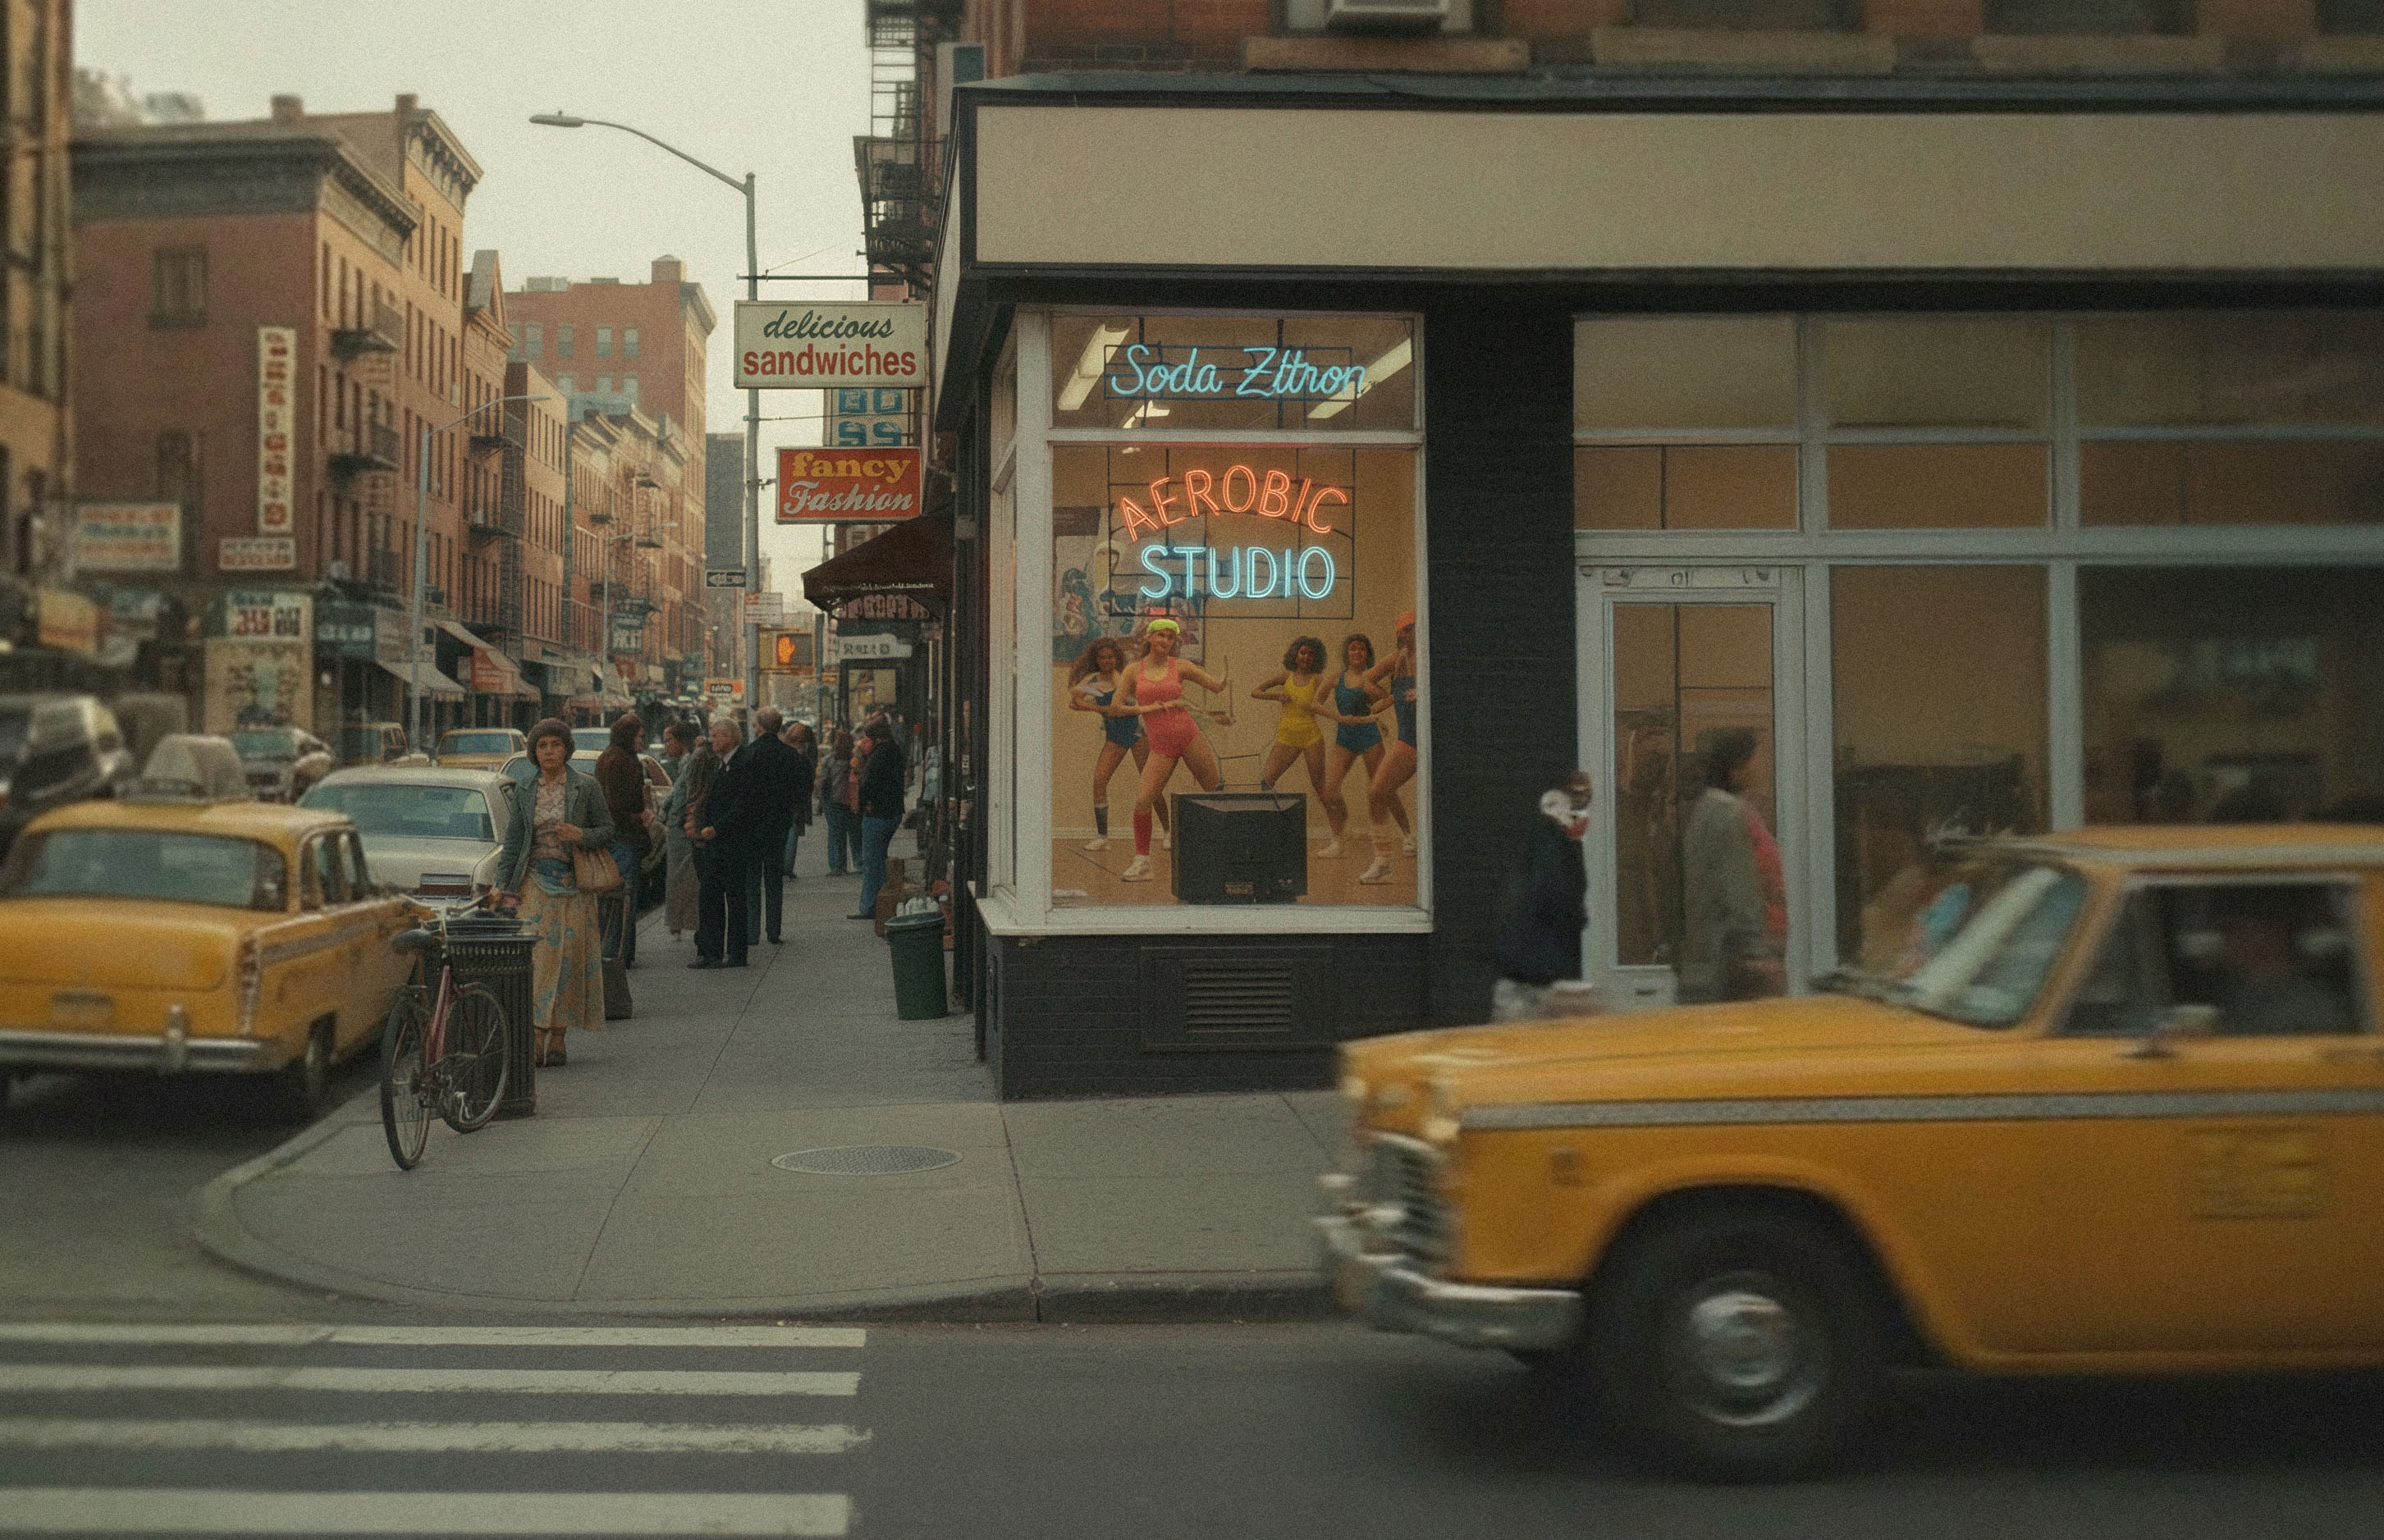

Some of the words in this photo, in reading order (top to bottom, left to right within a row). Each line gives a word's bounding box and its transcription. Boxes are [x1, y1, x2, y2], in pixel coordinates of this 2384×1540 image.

[763, 309, 895, 340] delicious
[743, 343, 917, 377] sandwiches
[1110, 343, 1223, 395] Soda
[792, 452, 912, 483] fancy
[783, 480, 914, 515] Fashion
[1119, 464, 1348, 543] AEROBIC
[1139, 543, 1336, 600] STUDIO
